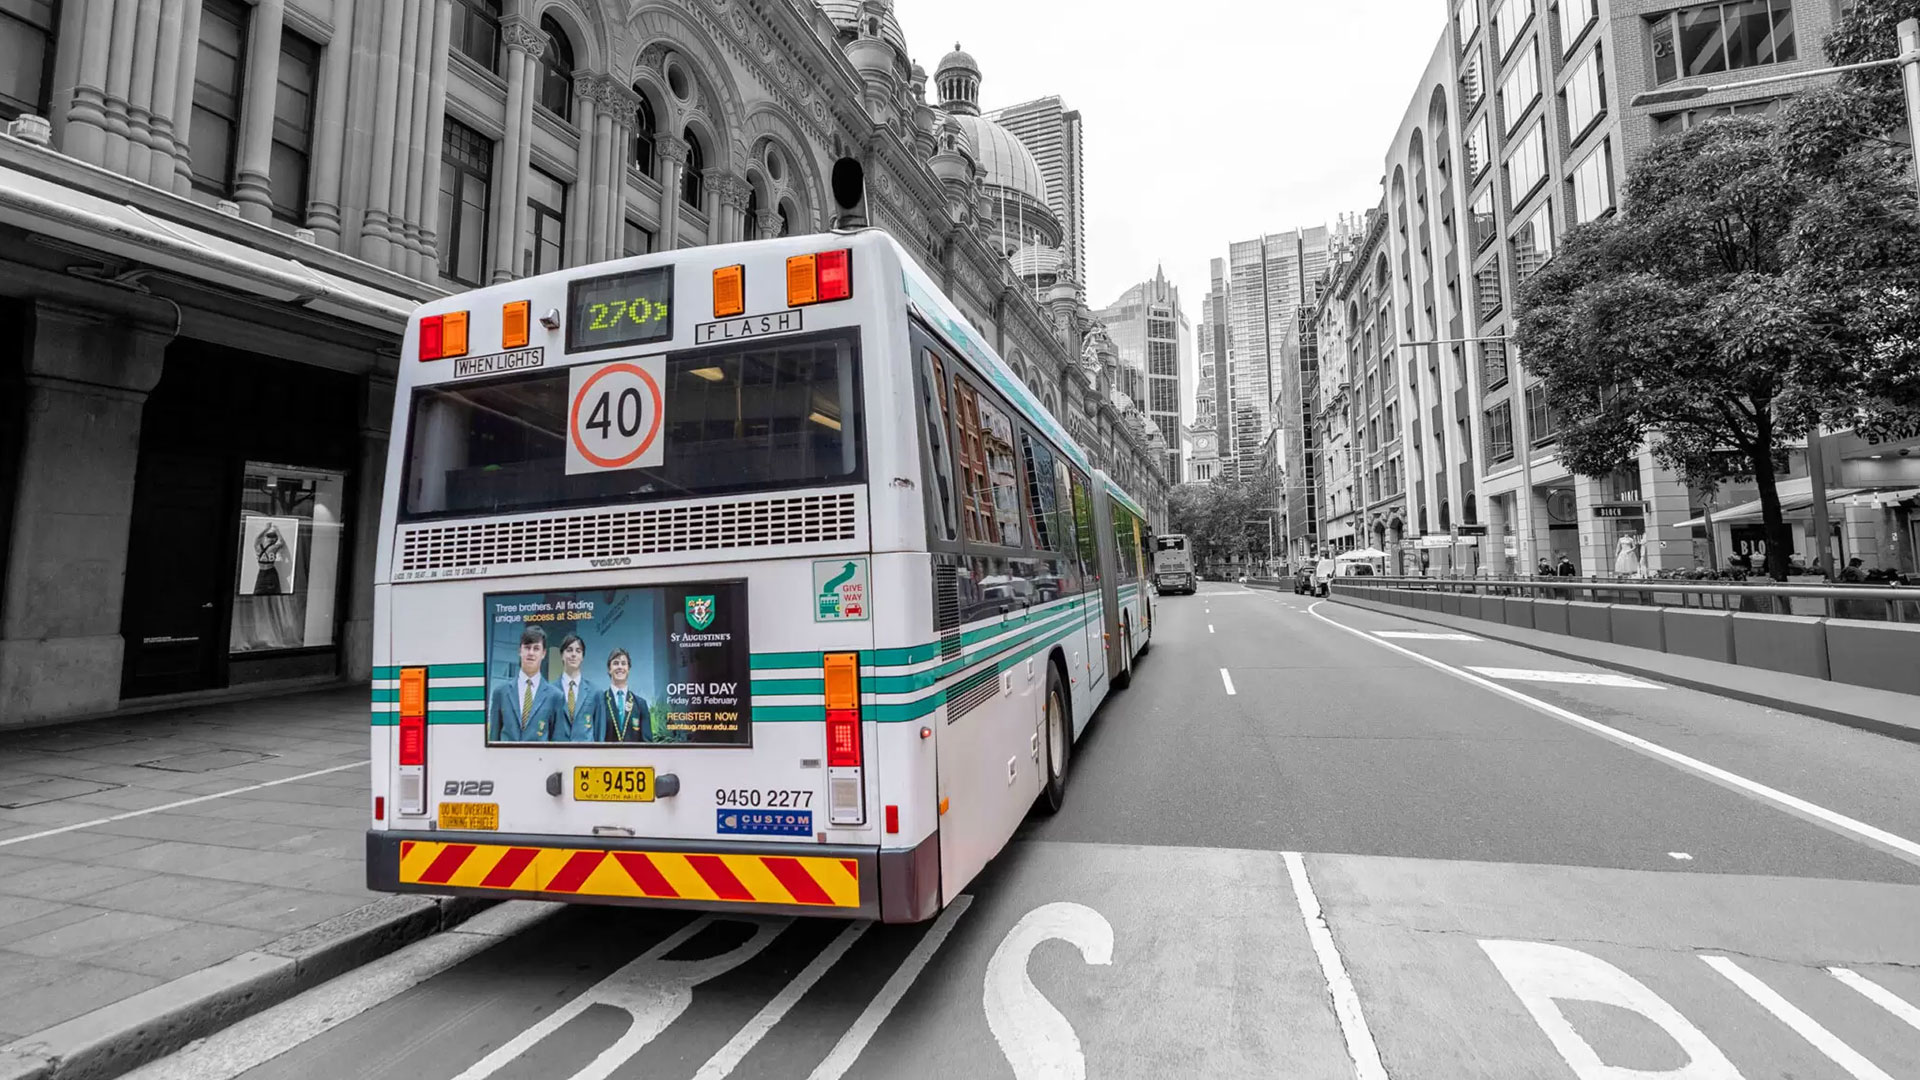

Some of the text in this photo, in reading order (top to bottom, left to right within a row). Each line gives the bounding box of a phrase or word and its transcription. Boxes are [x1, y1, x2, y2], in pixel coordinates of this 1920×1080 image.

[708, 316, 790, 340] FLASH
[458, 351, 539, 375] WHEN LIGHTS
[586, 387, 642, 439] 40
[842, 584, 862, 592] GIVE
[496, 600, 594, 612] Three brothers. All finding
[495, 611, 594, 623] unique success at Saints.
[666, 683, 737, 695] OPEN DAY
[667, 697, 689, 706] Friday
[704, 697, 737, 705] February
[667, 713, 711, 721] REGISTER
[666, 724, 738, 732] saintaug.nsw.edu.au
[603, 771, 646, 792] 9458
[716, 789, 813, 808] 9450 2277
[742, 815, 809, 824] CUSTOM
